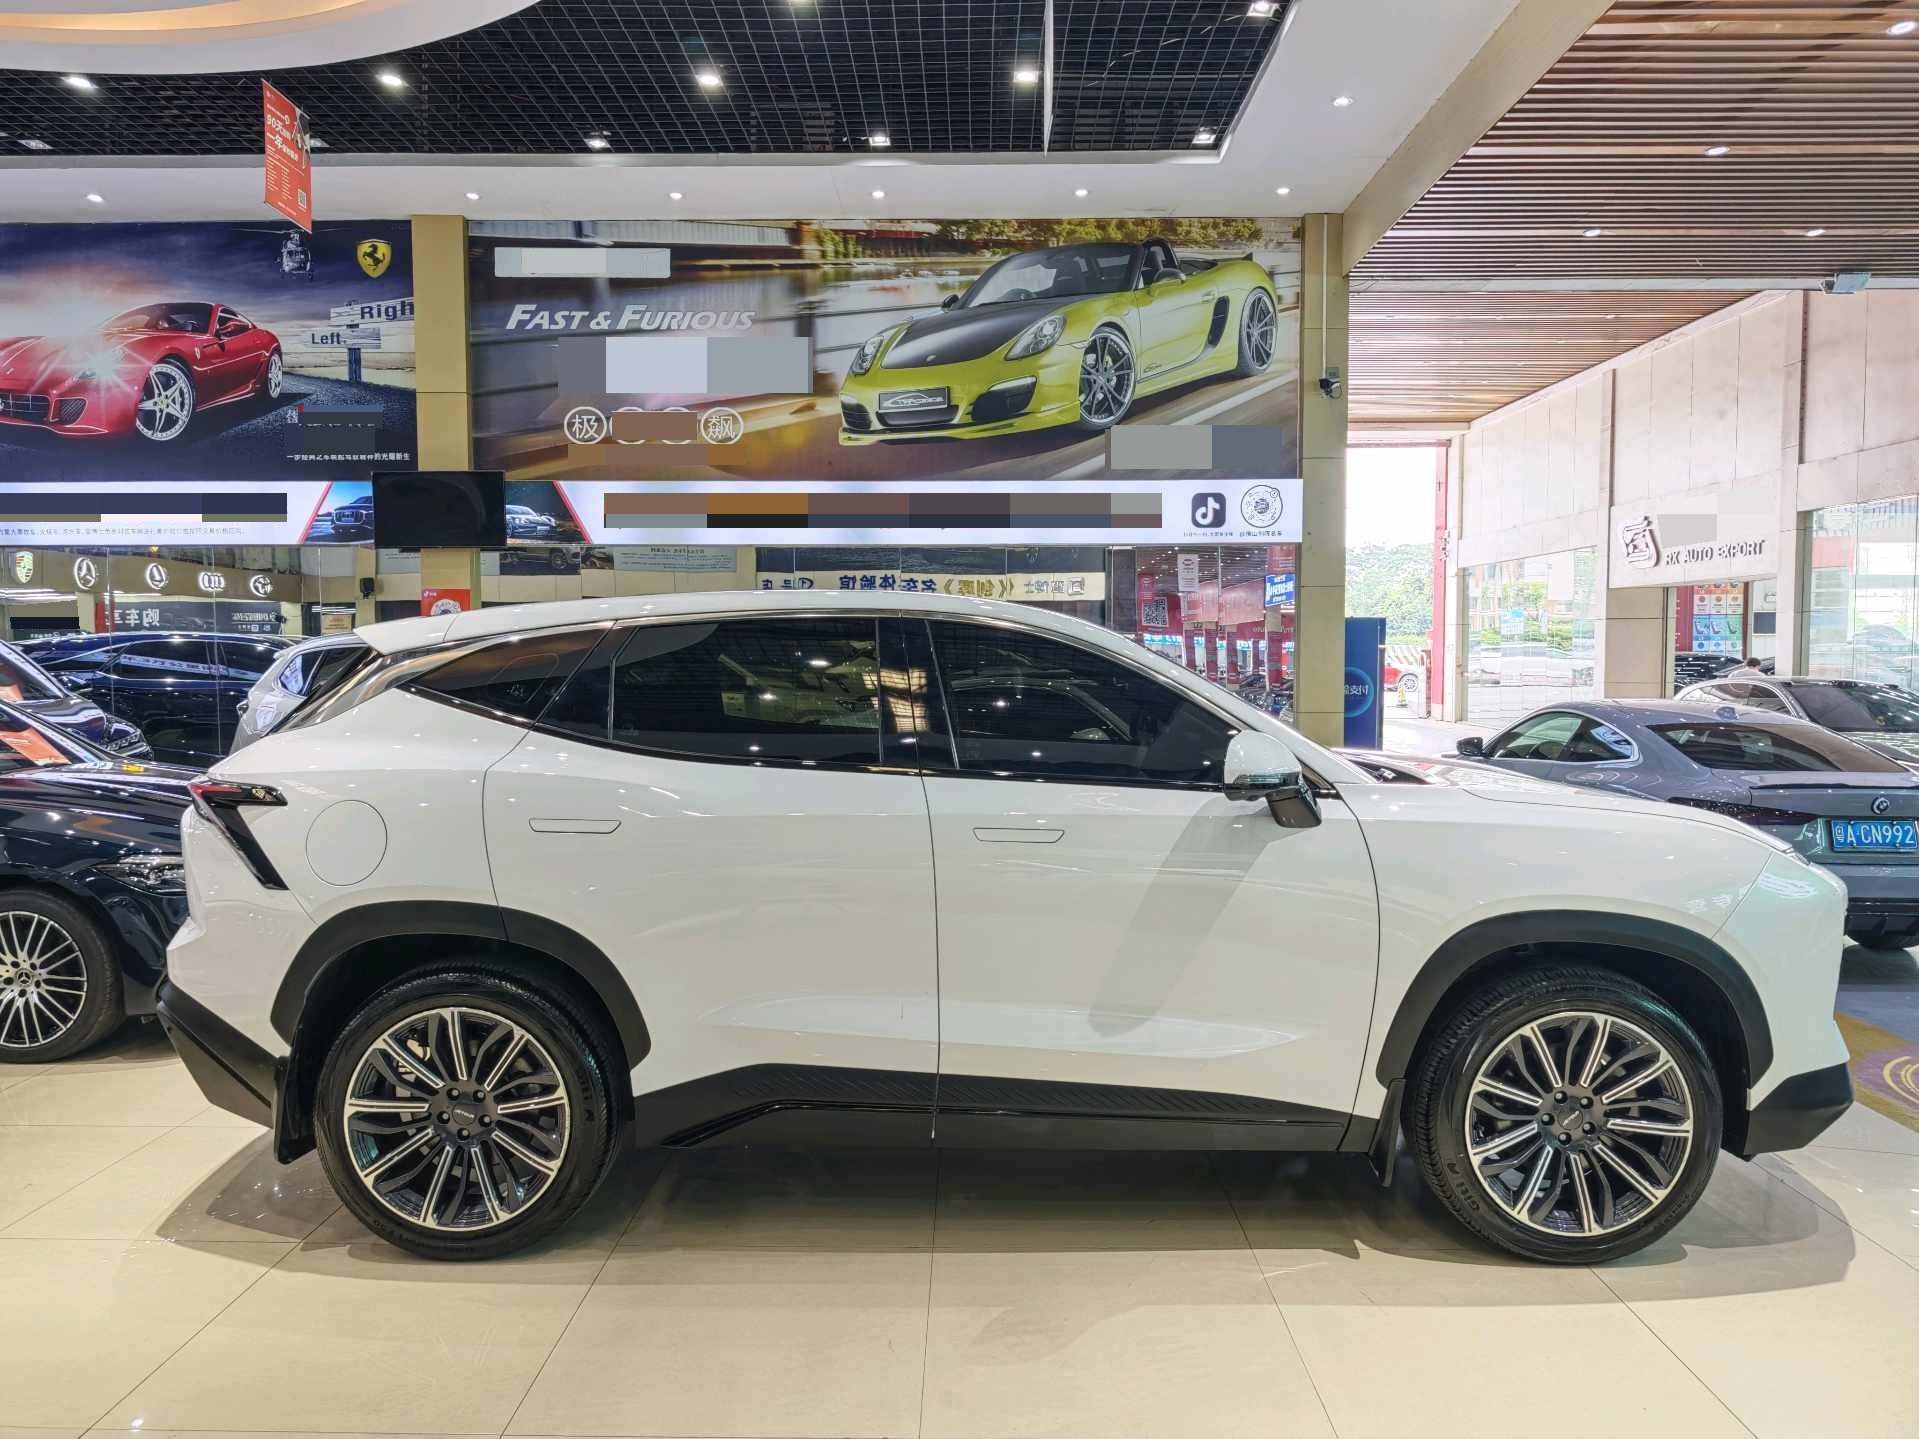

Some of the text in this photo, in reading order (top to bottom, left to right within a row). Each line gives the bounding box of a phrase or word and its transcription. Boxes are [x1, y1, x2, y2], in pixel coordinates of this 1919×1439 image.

[505, 304, 756, 330] FAST & FURIOUS
[1683, 546, 1714, 564] AUTO
[1717, 539, 1766, 560] EXPORT
